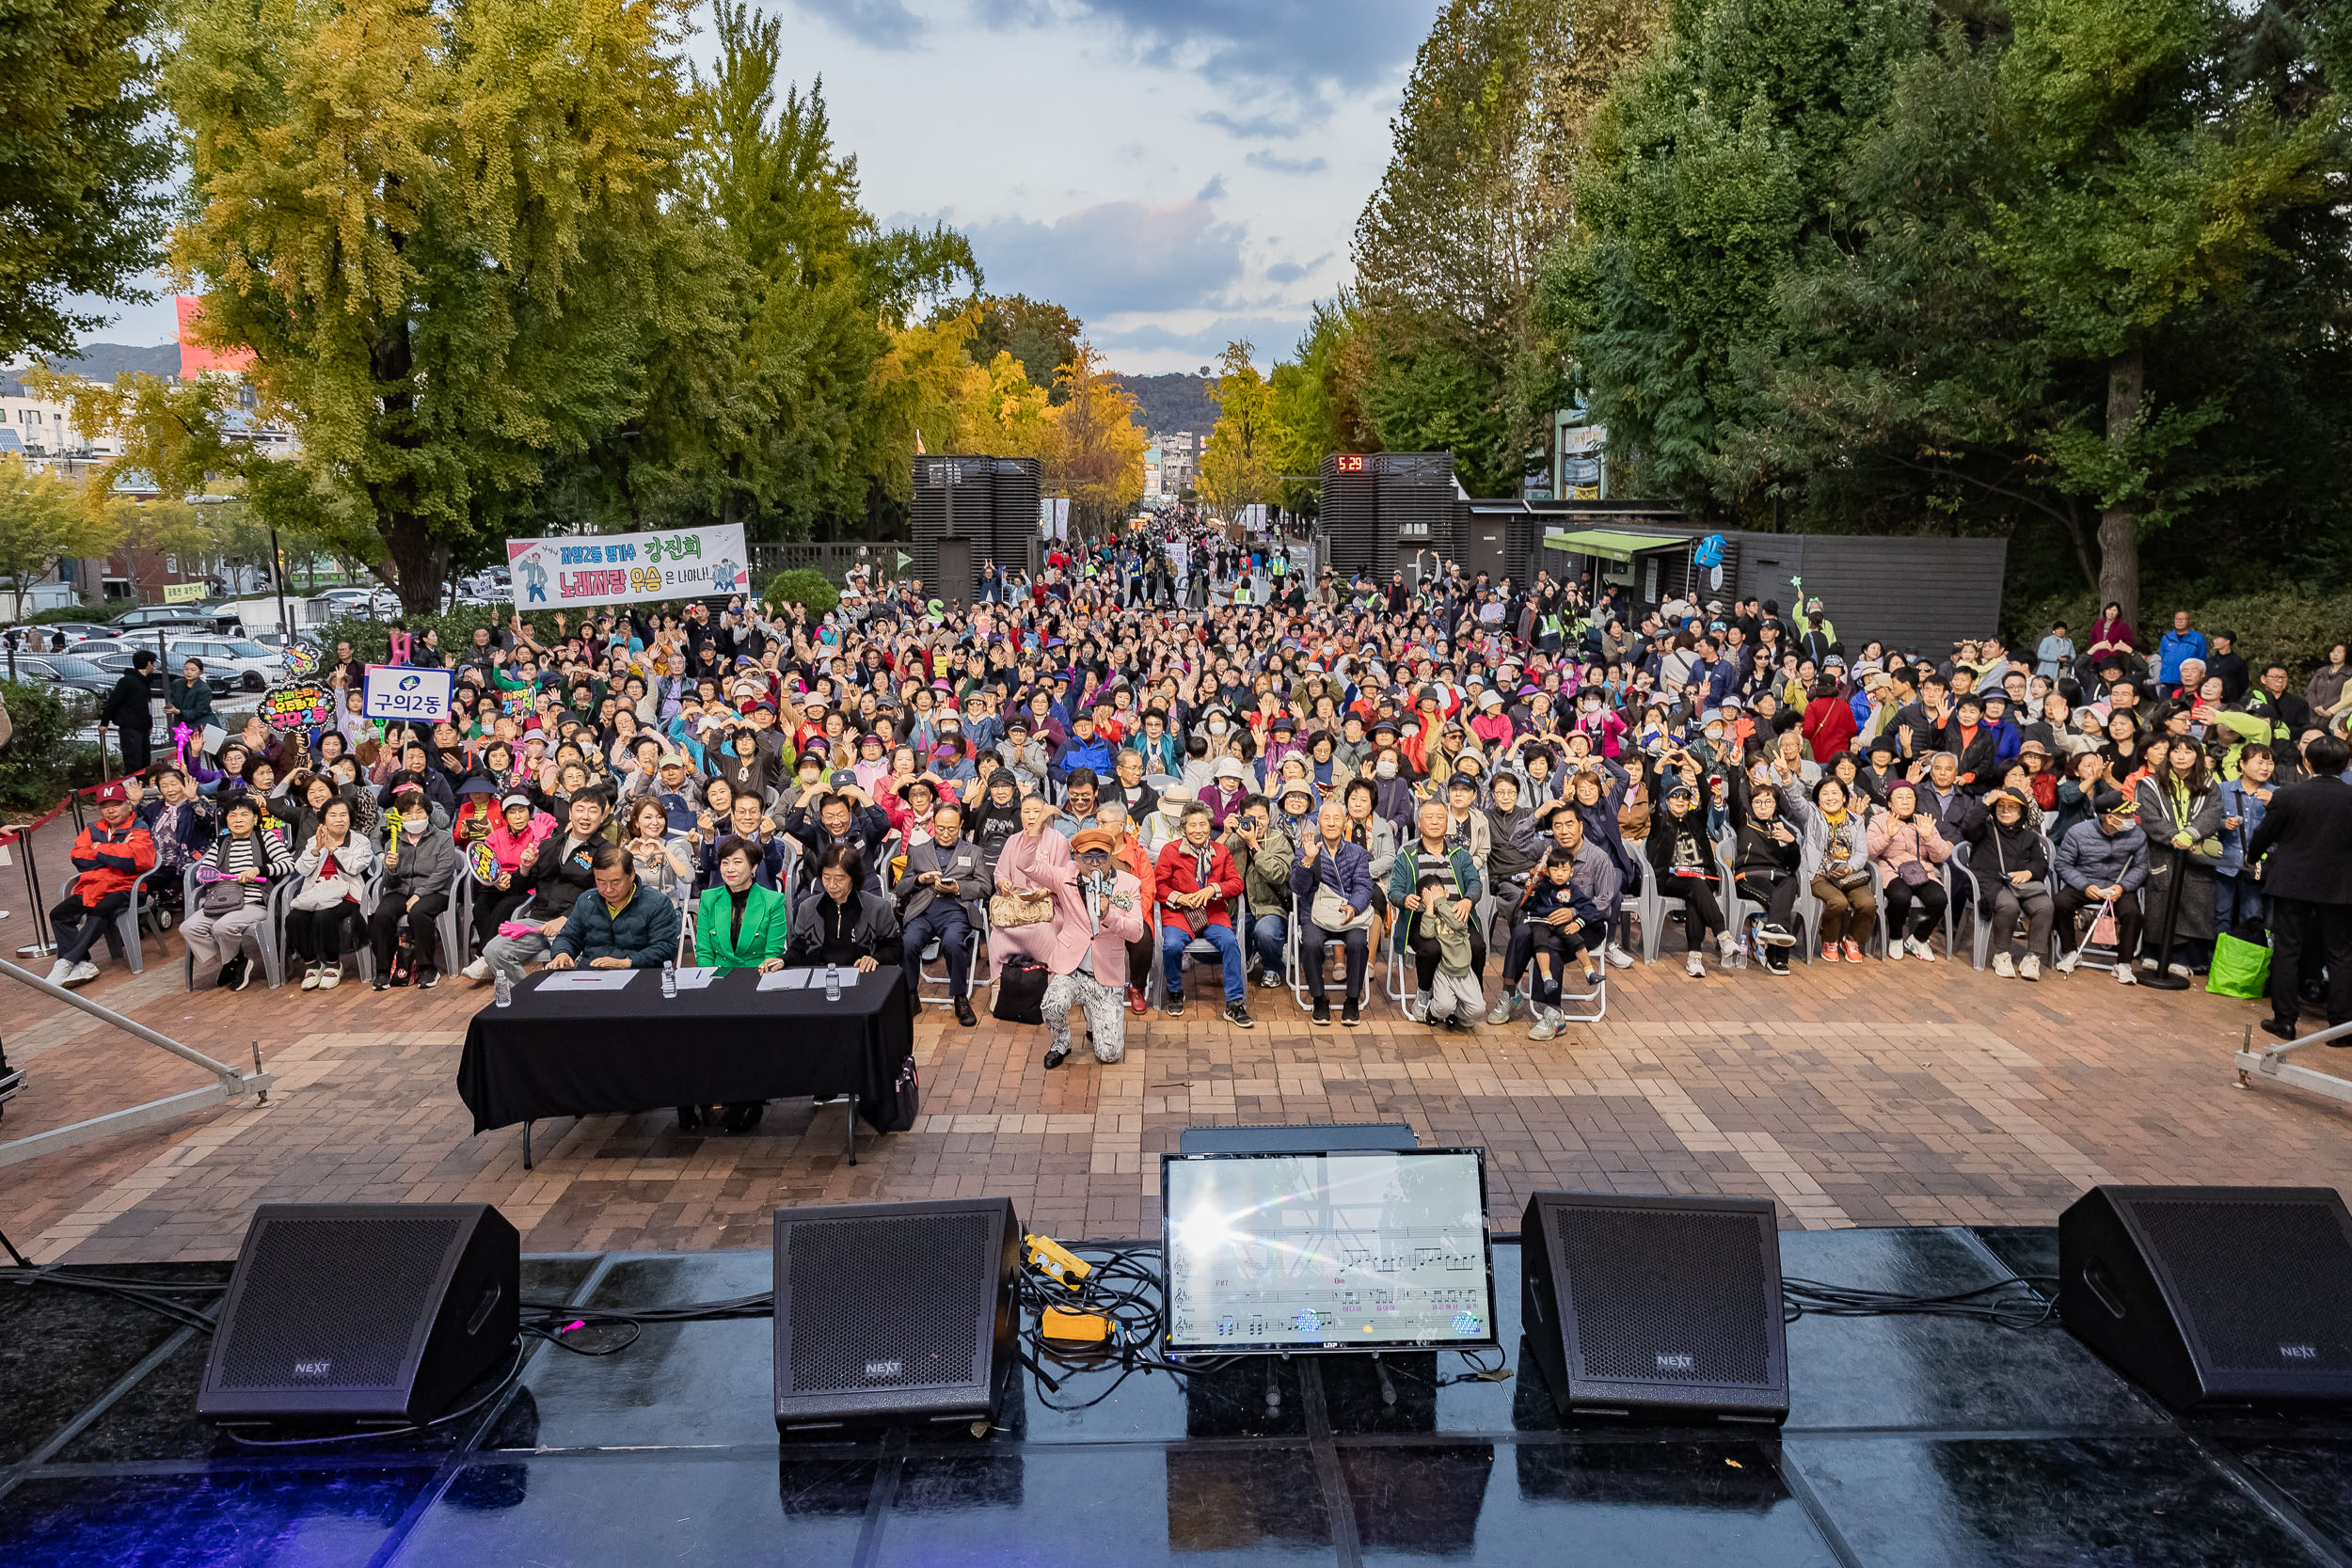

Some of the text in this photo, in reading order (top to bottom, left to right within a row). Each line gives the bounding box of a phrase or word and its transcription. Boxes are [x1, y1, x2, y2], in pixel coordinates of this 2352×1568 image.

[560, 533, 701, 564] 자양2동 명가수 강진희
[559, 565, 709, 598] 노래자랑 우승 은 나야나!
[275, 688, 314, 703] 슈퍼스타
[374, 693, 441, 714] 구의2동
[271, 705, 327, 729] 구의2동
[103, 786, 115, 798] N
[2280, 1345, 2316, 1358] NEXT
[294, 1361, 329, 1375] NEXT
[866, 1360, 900, 1376] NEXT
[1657, 1354, 1692, 1369] NEXT
